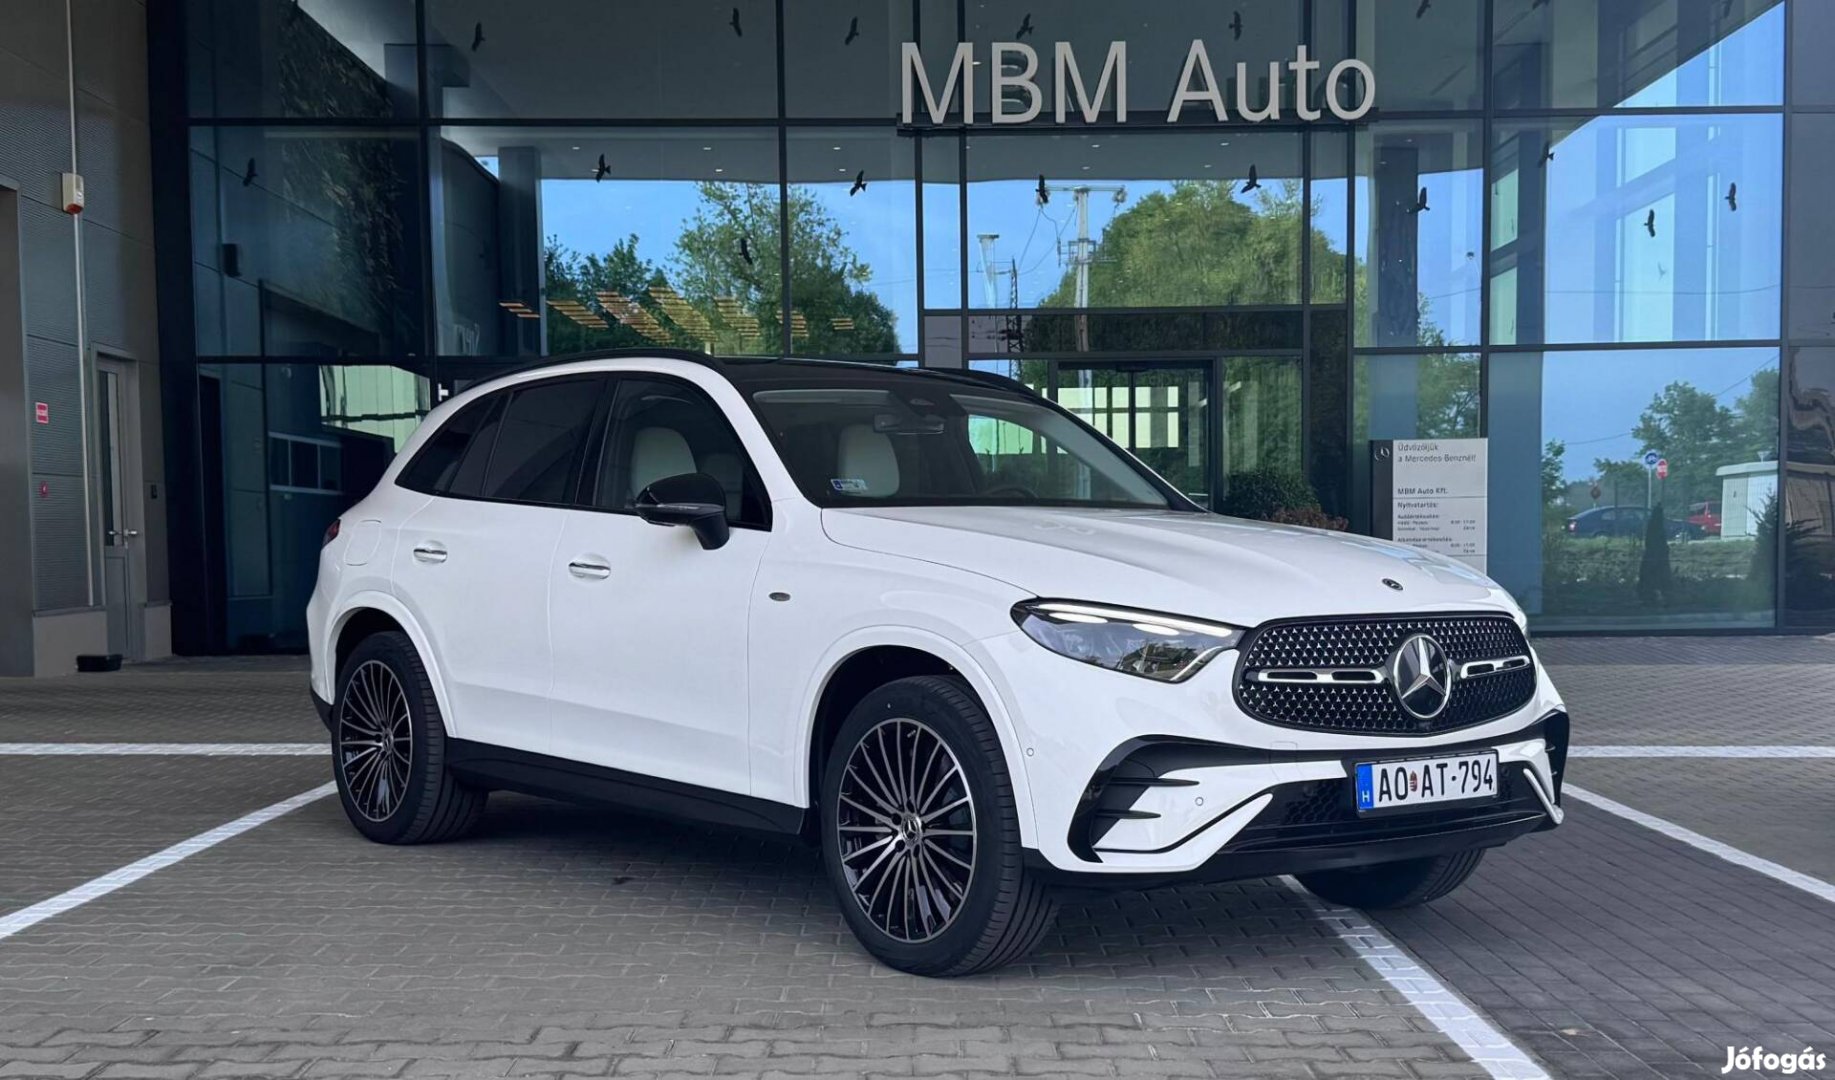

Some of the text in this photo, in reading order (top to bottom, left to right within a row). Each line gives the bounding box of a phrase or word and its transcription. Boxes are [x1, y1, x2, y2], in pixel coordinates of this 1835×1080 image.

[901, 38, 1376, 125] MBM Auto
[1397, 487, 1416, 496] MBM
[1417, 487, 1435, 496] Auto
[1362, 790, 1370, 803] H
